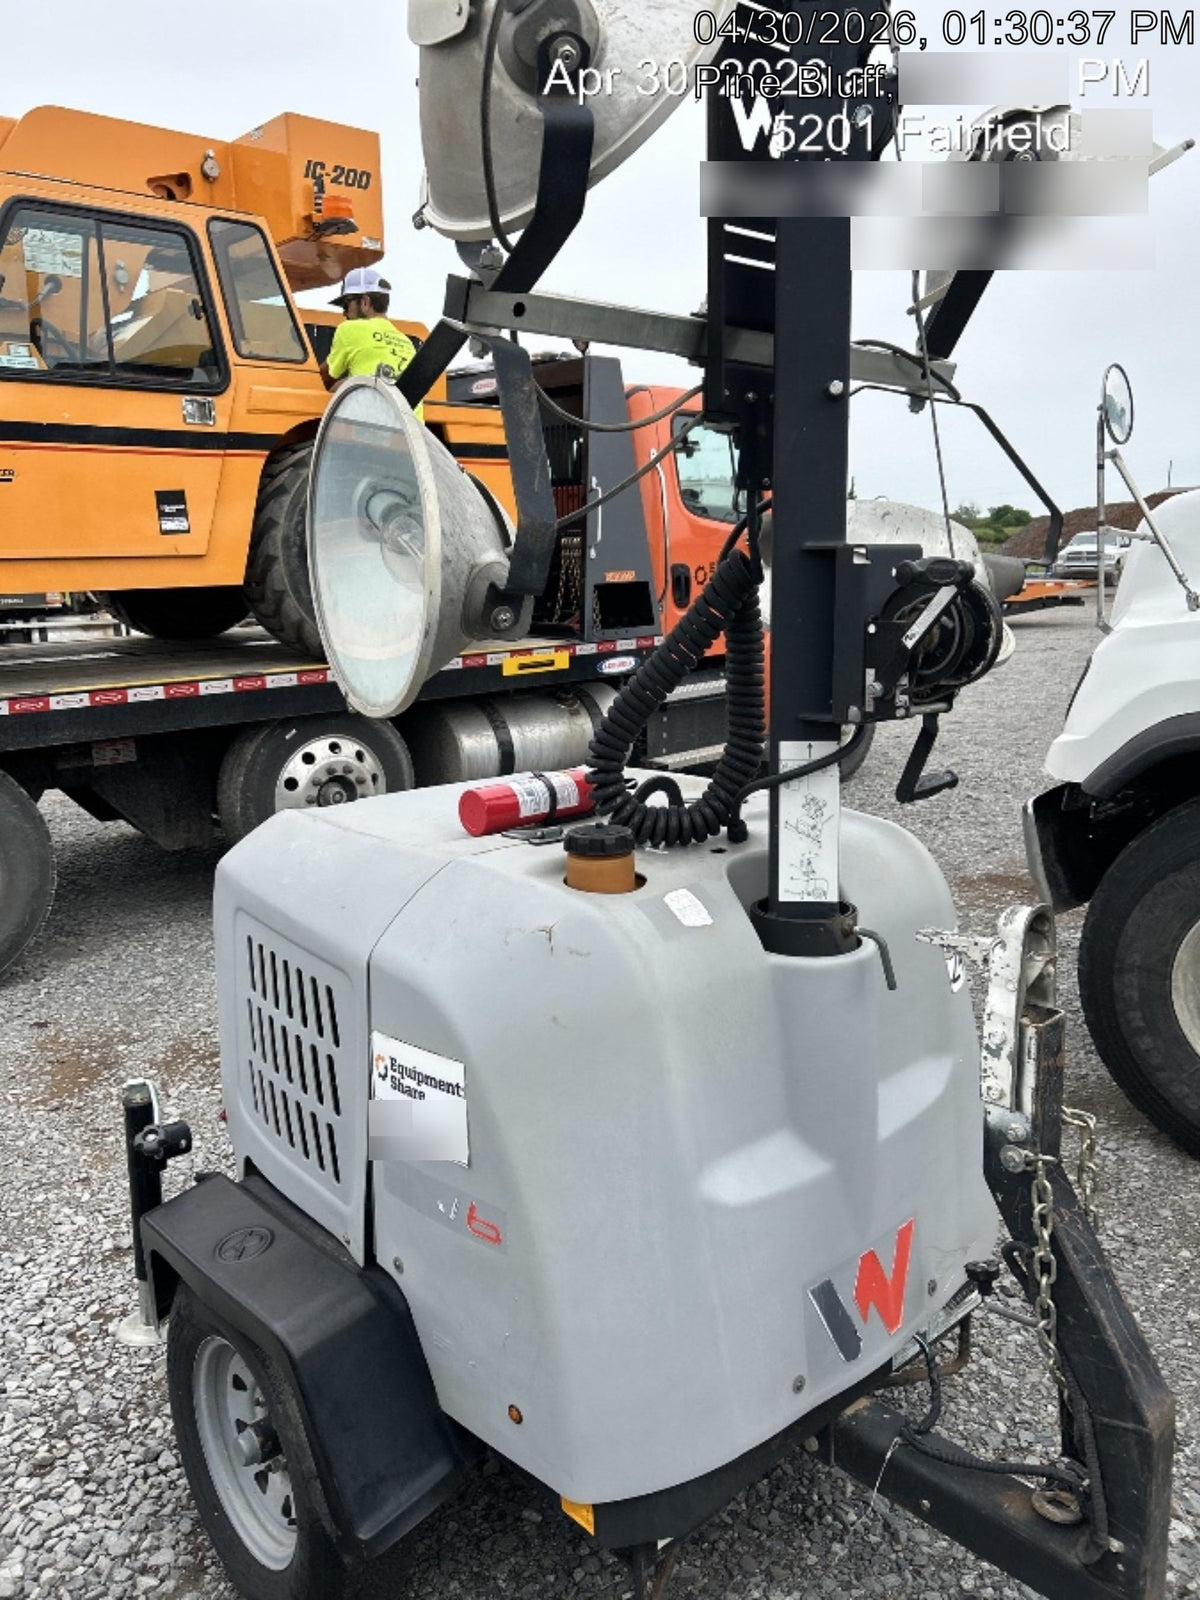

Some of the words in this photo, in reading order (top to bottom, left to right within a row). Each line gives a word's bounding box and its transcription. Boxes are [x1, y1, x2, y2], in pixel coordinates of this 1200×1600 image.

[304, 160, 371, 190] IC-200
[389, 1056, 463, 1097] Equipment
[390, 1075, 425, 1101] Share
